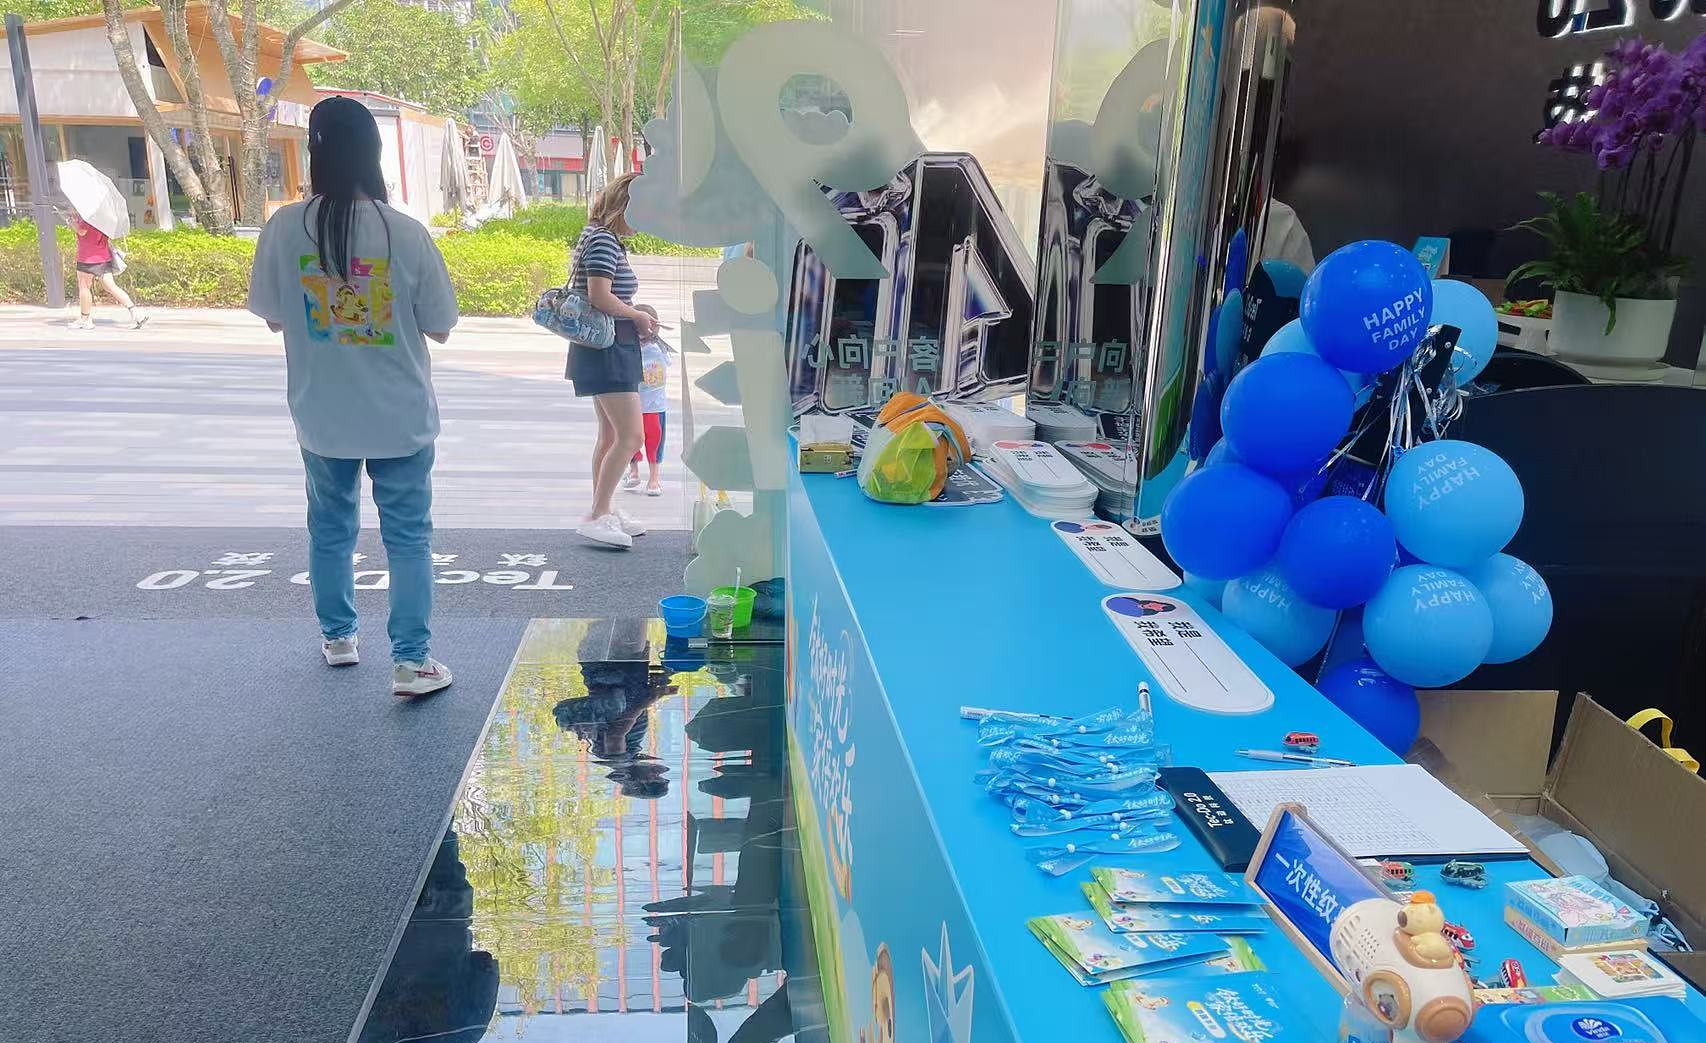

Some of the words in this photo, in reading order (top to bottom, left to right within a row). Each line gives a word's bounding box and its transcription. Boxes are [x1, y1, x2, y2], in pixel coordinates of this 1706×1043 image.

[1363, 288, 1424, 330] HAPPY
[1372, 307, 1426, 344] FAMILY
[1388, 327, 1418, 350] DAY
[1412, 456, 1469, 495] FAMILY
[1417, 453, 1448, 475] DAY
[1419, 466, 1481, 511] HAPPY
[134, 568, 272, 591] 2.0
[1411, 578, 1466, 598] FAMILY
[1417, 570, 1448, 583] DAY
[1415, 590, 1477, 612] HAPPY
[1134, 620, 1175, 647] 我希望
[1168, 620, 1202, 639] 我是
[1196, 803, 1223, 828] Tec-Do
[1275, 852, 1346, 925] 一次性纹
